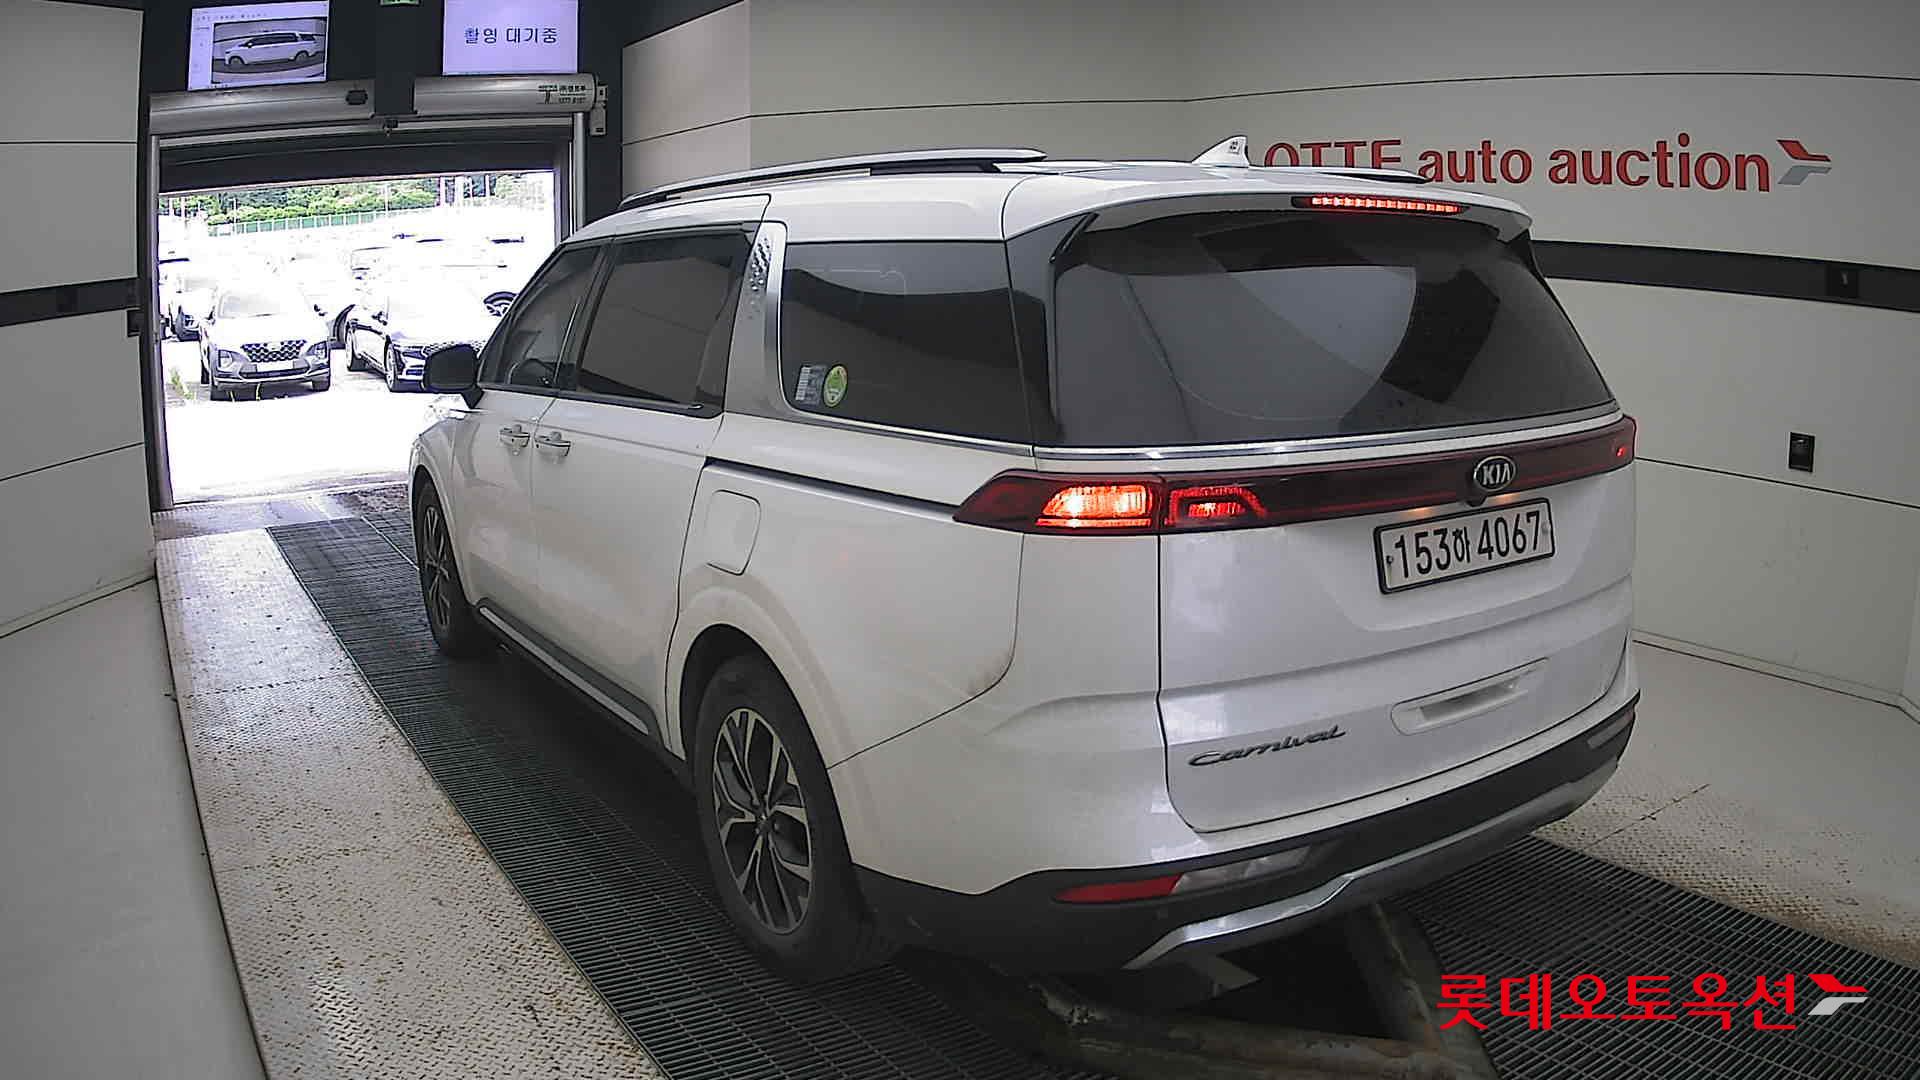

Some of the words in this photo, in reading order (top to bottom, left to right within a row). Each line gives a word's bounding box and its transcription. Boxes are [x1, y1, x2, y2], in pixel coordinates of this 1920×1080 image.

[506, 28, 557, 44] 대기중
[1264, 140, 1401, 169] OTTE
[1418, 139, 1533, 184] auto
[1548, 132, 1771, 192] auction
[1482, 462, 1511, 486] KIA
[1394, 526, 1471, 579] 153하
[1477, 510, 1540, 561] 4067
[1188, 725, 1346, 767] Carnival
